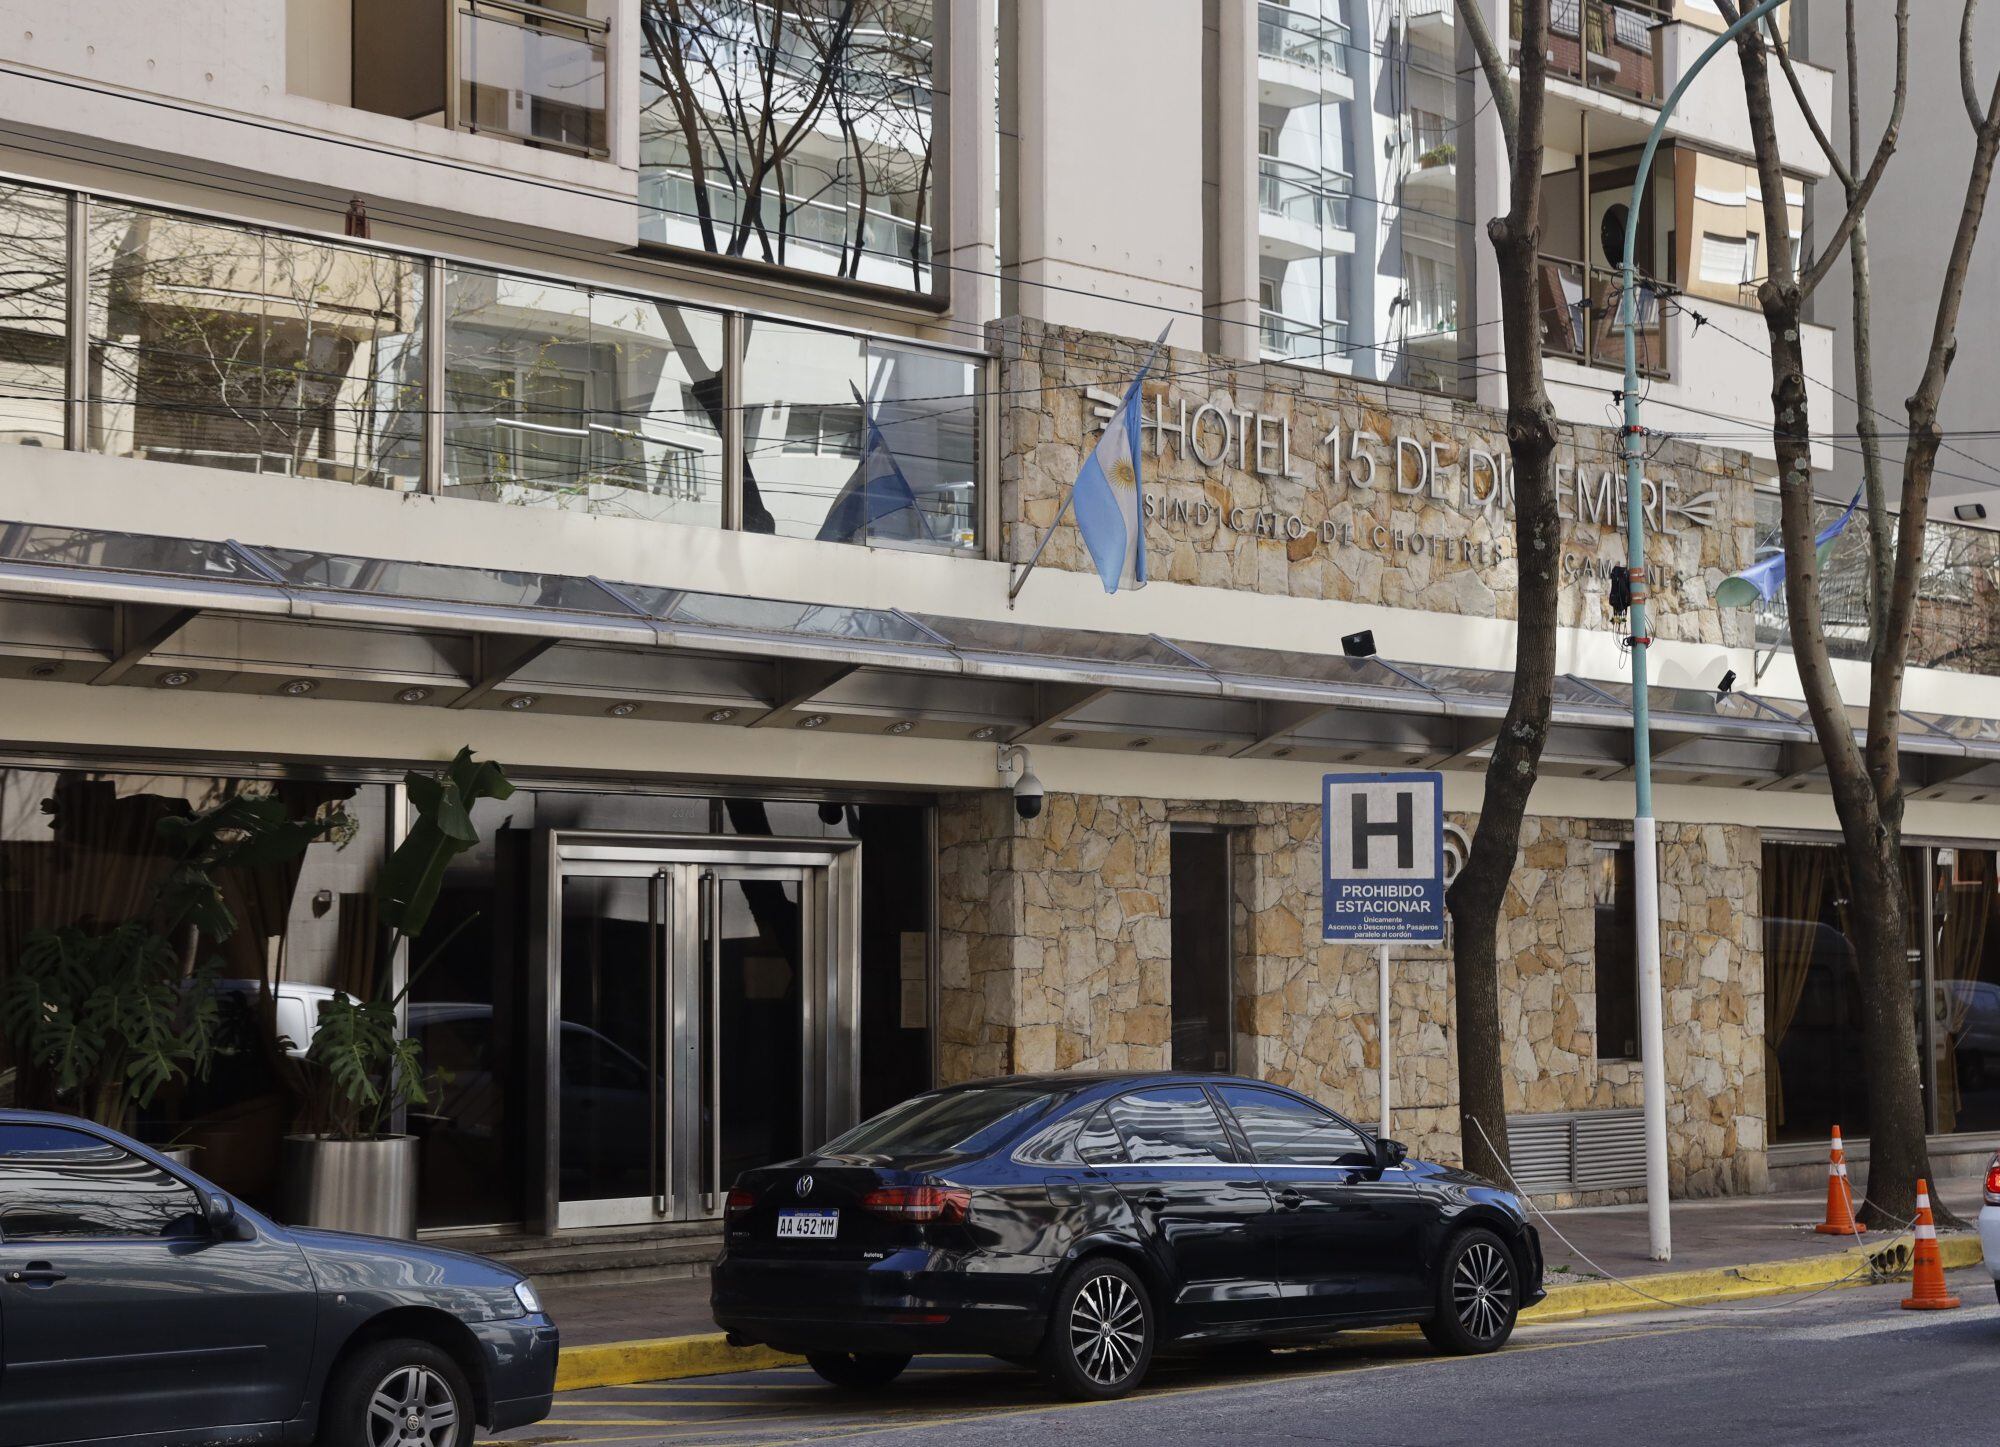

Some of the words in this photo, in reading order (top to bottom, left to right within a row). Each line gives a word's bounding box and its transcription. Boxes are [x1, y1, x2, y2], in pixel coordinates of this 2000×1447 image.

[1155, 393, 1303, 478] HOTEL
[1324, 425, 1377, 489] 15
[1397, 435, 1451, 500] DE
[1145, 493, 1303, 540] SINDICATO
[1323, 520, 1354, 546] DE
[1373, 525, 1503, 563] CHOFERES
[1565, 552, 1684, 590] CAMNES
[1351, 792, 1414, 869] H
[1342, 885, 1425, 898] PROHIBIDO
[1335, 900, 1432, 913] ESTACIONAR
[1327, 923, 1357, 931] Ascenso
[1363, 923, 1396, 931] Descenso
[1396, 923, 1405, 931] de
[1406, 923, 1439, 932] Pasajeros
[1354, 931, 1381, 939] paralelo
[779, 1218, 793, 1235] AA
[796, 1218, 817, 1235] 452
[819, 1218, 835, 1235] MM
